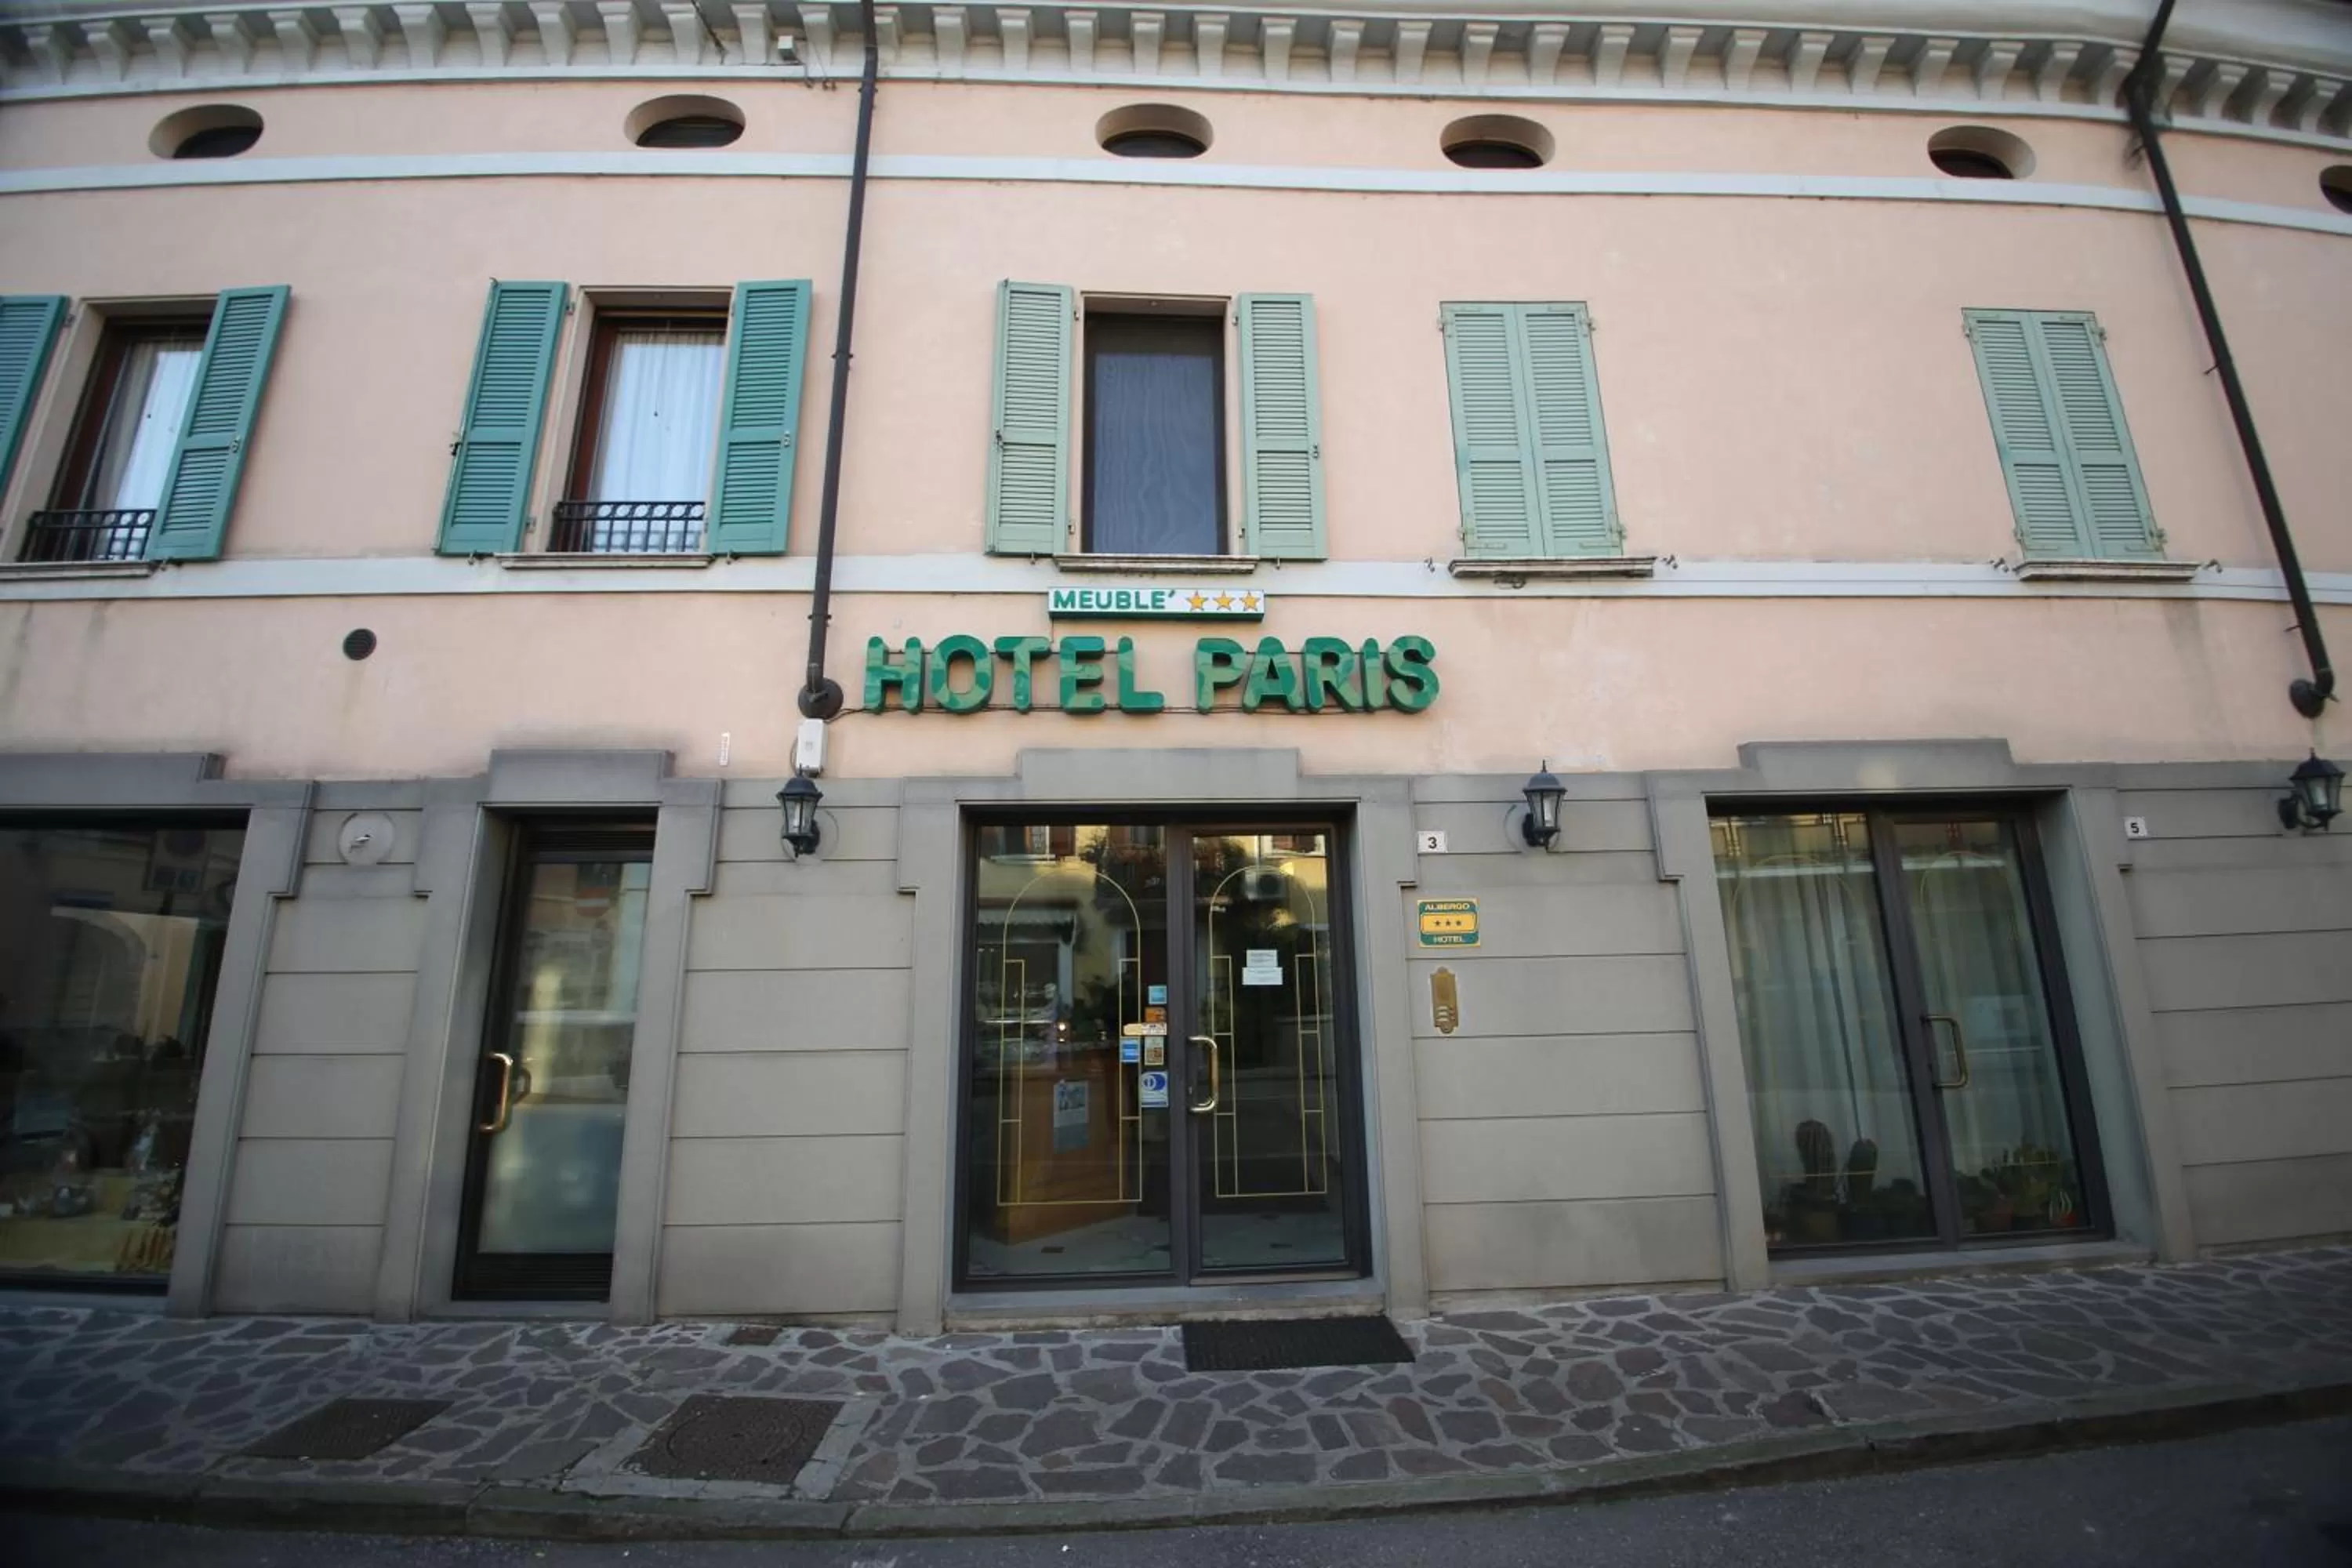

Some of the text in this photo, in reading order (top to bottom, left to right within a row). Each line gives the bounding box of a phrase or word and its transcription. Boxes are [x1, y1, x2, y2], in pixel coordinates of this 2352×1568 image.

[863, 635, 1441, 715] HOTEL PARIS
[2131, 822, 2140, 833] 5
[1428, 837, 1437, 849] 3
